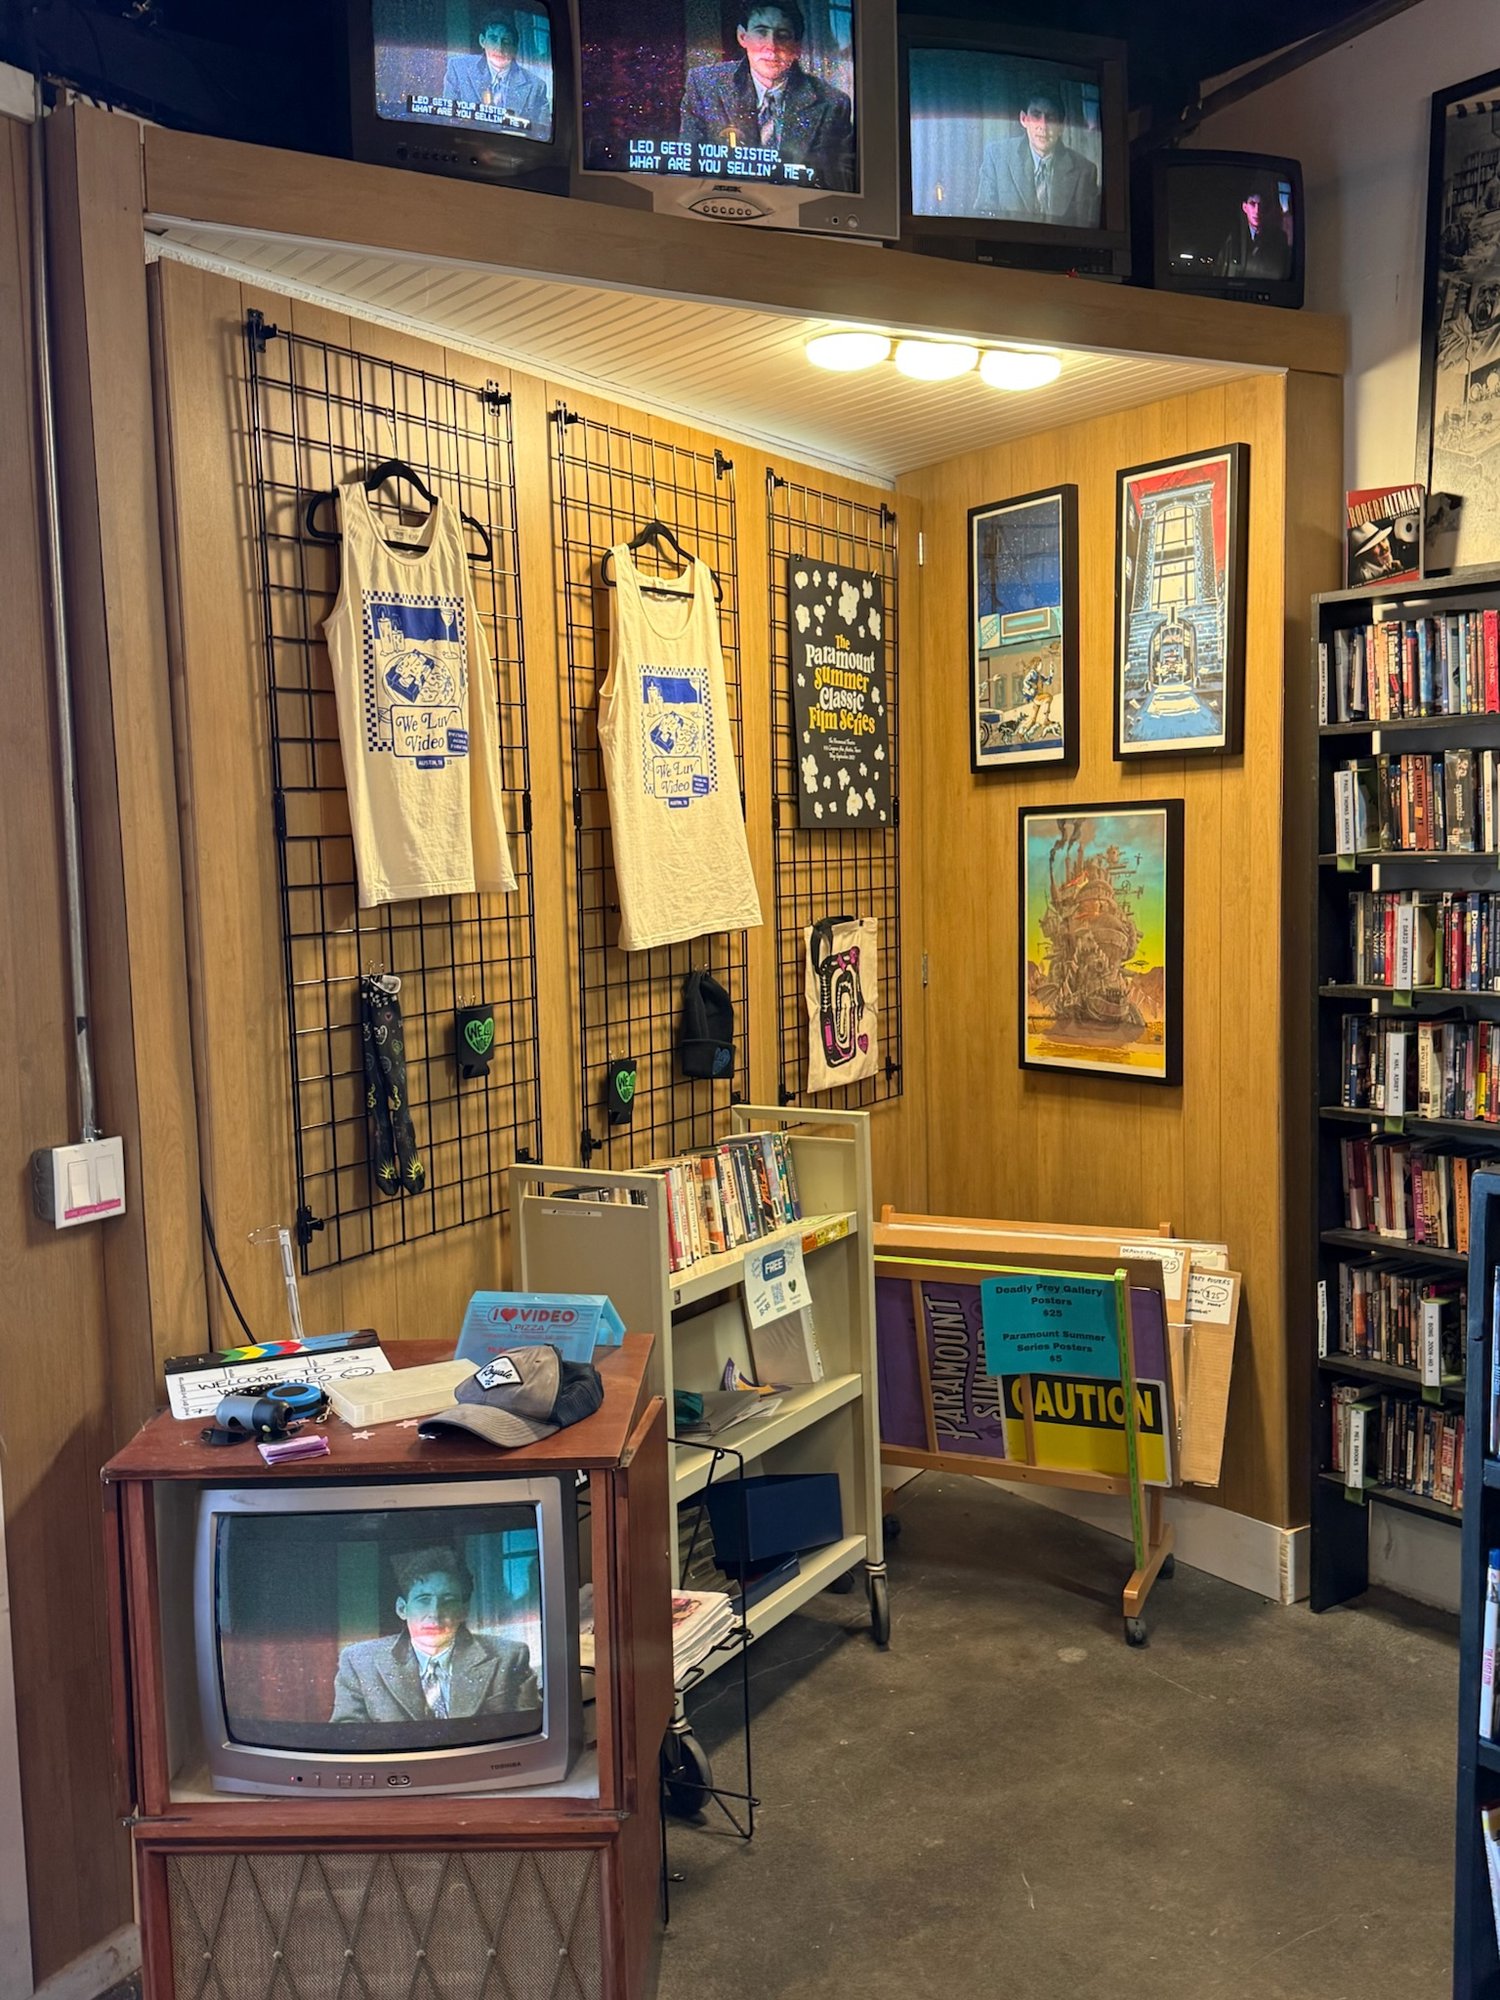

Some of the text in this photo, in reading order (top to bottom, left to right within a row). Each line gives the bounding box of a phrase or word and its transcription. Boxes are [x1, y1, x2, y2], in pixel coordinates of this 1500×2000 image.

[412, 95, 428, 104] LEO
[432, 97, 453, 106] GETS
[457, 101, 476, 110] YOUR
[412, 104, 432, 113] WHAT
[437, 107, 452, 117] ARE
[456, 109, 472, 118] YOU
[629, 140, 782, 163] LEO GETS YOUR SISTER.
[629, 156, 661, 169] WHAT
[668, 157, 691, 171] ARE
[698, 159, 721, 173] YOU
[727, 161, 776, 177] SELLIN'
[1348, 486, 1419, 528] ROBERT ALTMAN
[835, 634, 850, 651] The
[805, 643, 875, 674] Paramount
[820, 686, 864, 714] Classic
[395, 710, 457, 732] We Luv
[808, 703, 875, 736] Film Series
[405, 733, 445, 753] Video
[656, 759, 699, 779] We Luv
[661, 780, 690, 794] Video
[1401, 924, 1409, 974] DARIO ARGENTO
[765, 1257, 784, 1275] FREE
[995, 1283, 1103, 1297] Deadly Prey Gallery
[1031, 1297, 1072, 1306] Posters
[493, 1309, 575, 1323] I VIDEO
[1043, 1309, 1062, 1318] $25
[514, 1324, 546, 1332] PIZZA
[1002, 1330, 1105, 1342] Paramount Summer
[1017, 1342, 1092, 1353] Series Posters
[924, 1294, 983, 1440] PARAMOUNT
[1049, 1354, 1062, 1363] $5
[198, 1367, 327, 1391] WELCOME TO
[1011, 1377, 1154, 1428] CAUTION
